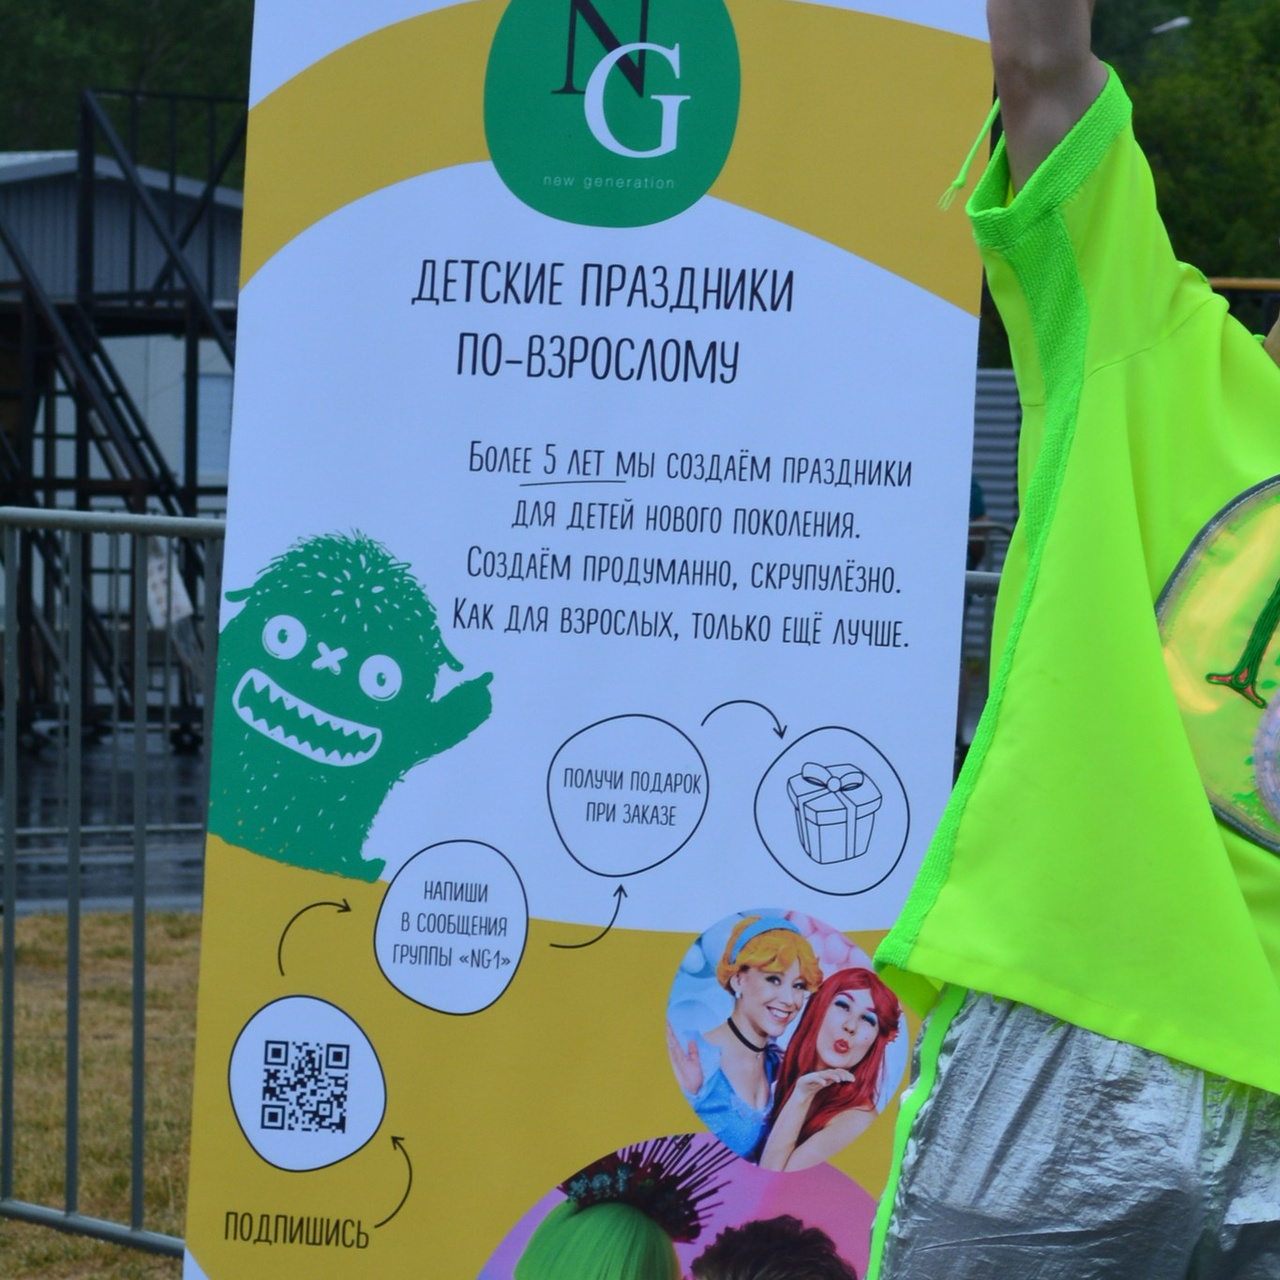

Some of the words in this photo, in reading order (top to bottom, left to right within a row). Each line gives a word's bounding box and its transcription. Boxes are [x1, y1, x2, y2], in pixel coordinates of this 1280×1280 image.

[543, 175, 575, 187] new
[583, 176, 675, 190] generation
[411, 259, 565, 306] ДЕТСКИЕ
[580, 263, 794, 314] ПРАЗДНИКИ
[457, 332, 740, 384] ПО-ВЗРОСЛОМУ
[563, 767, 624, 790] ПОЛУЧИ
[630, 770, 702, 795] ПОДАРОК
[585, 801, 617, 823] ПРИ
[622, 803, 677, 827] ЗАКАЗЕ
[423, 880, 489, 903] НАПИШИ
[400, 911, 411, 932] В
[416, 912, 508, 937] СООБЩЕНИЯ
[392, 943, 453, 967] ГРУППЫ
[459, 948, 511, 970] «NG1»
[224, 1211, 370, 1249] ПОДПИШИСЬ
